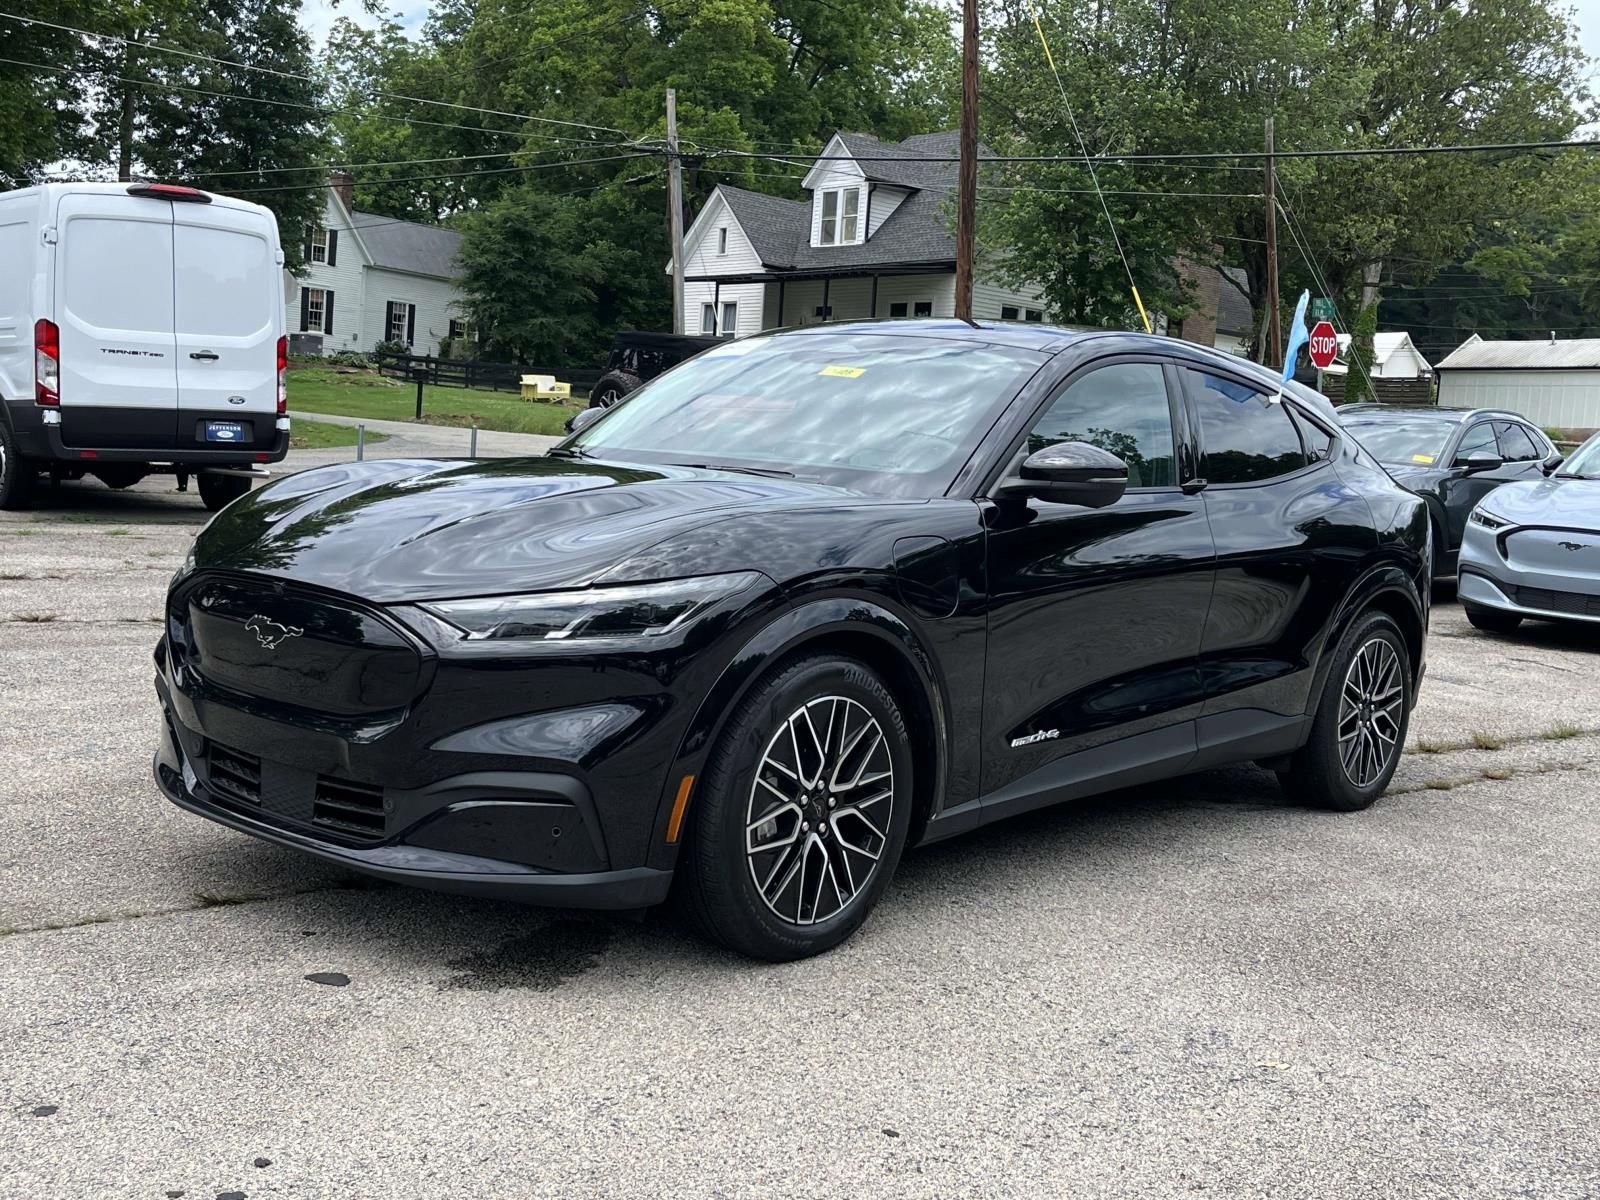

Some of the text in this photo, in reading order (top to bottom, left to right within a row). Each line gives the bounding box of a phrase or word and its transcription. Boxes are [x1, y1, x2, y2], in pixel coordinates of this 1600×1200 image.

[99, 348, 149, 357] TRANSIT
[1311, 336, 1335, 354] STOP
[843, 664, 909, 744] BRIDGESTONE
